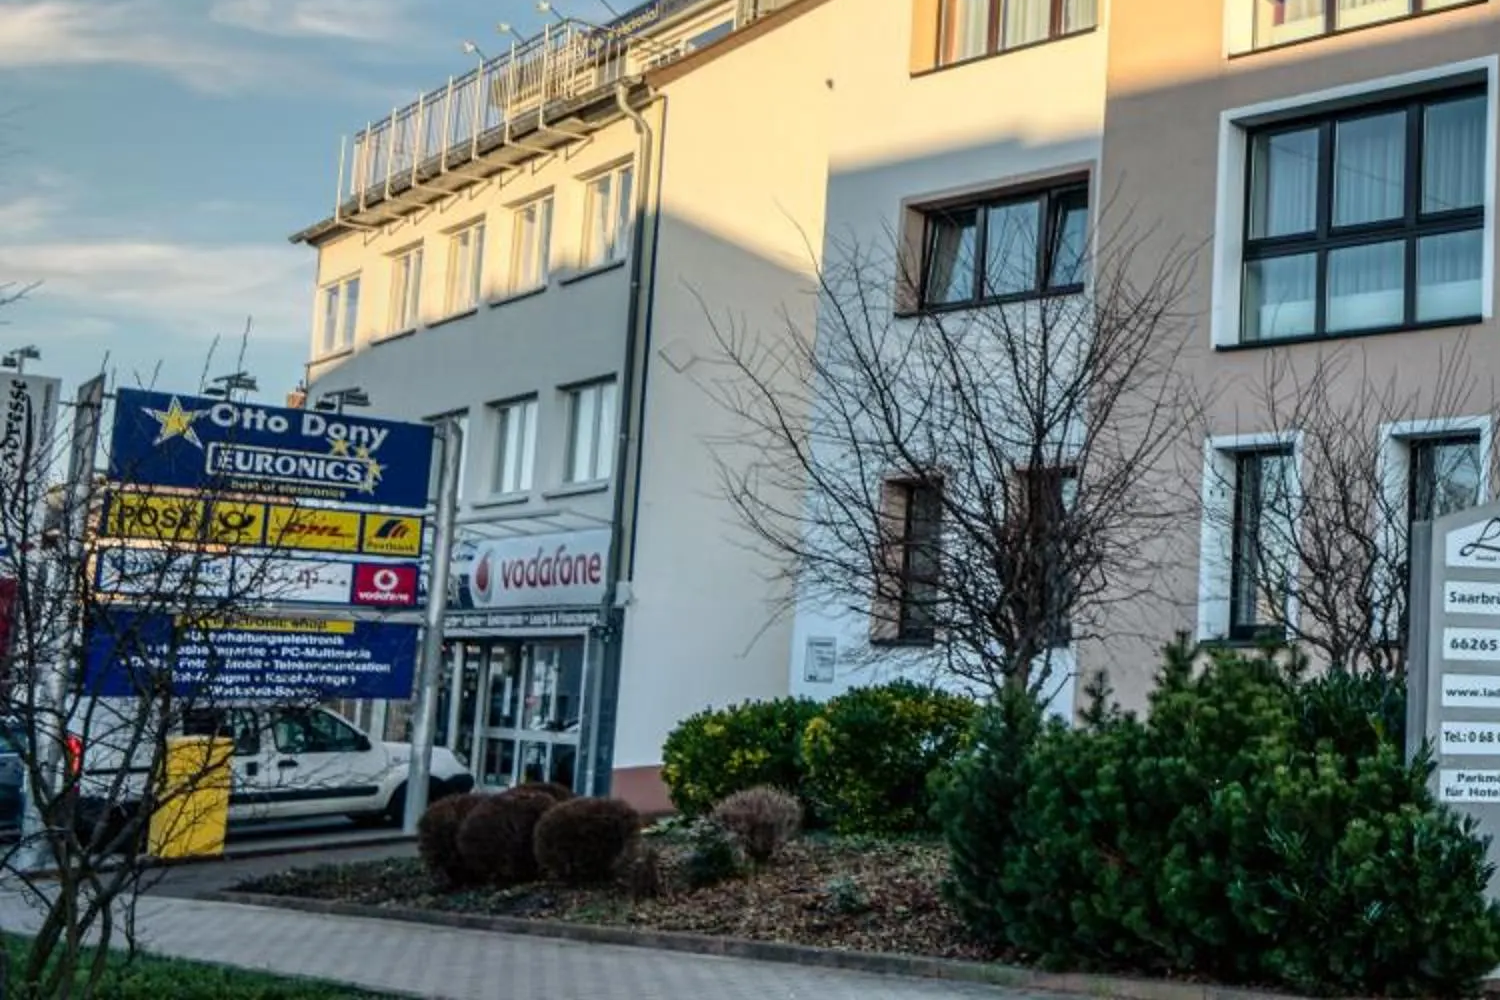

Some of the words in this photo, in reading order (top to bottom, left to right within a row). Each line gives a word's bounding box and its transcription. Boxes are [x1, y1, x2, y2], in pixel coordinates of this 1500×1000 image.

[209, 402, 290, 433] Otto
[301, 412, 390, 450] Dony
[216, 448, 362, 483] EURONICS
[502, 544, 601, 590] vodafone
[357, 590, 410, 602] vodafone
[1450, 638, 1498, 651] 66265
[1444, 787, 1464, 797] für
